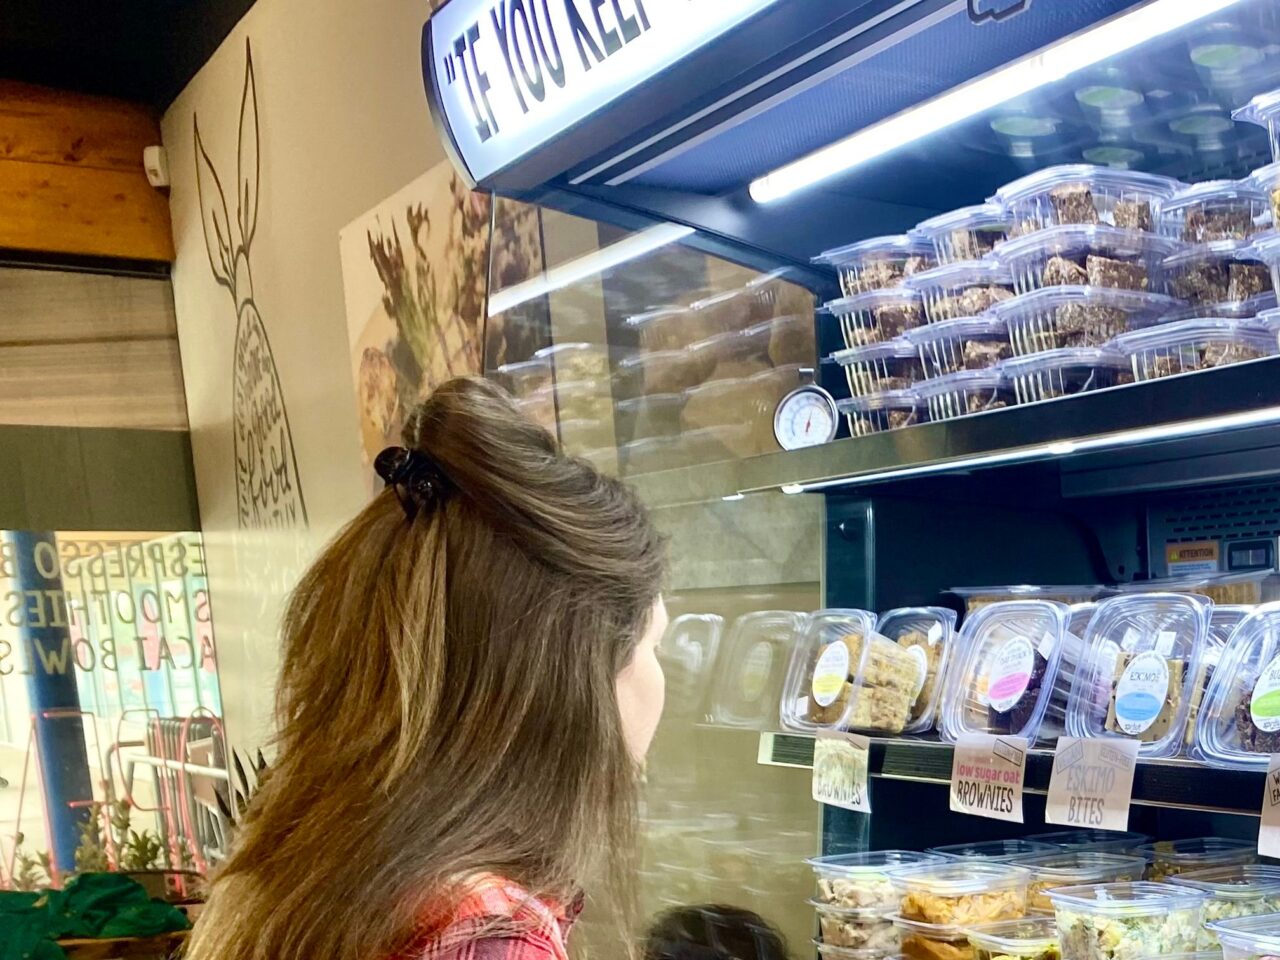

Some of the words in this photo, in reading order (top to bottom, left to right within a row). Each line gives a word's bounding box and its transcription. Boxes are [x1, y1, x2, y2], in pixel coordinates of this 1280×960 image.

[489, 0, 566, 113] YOU
[957, 761, 973, 778] low
[975, 764, 1002, 783] sugar
[1004, 770, 1021, 784] oat
[1067, 767, 1116, 794] ESKIMO
[957, 781, 1014, 813] BROWNIES
[1067, 796, 1105, 825] BITES
